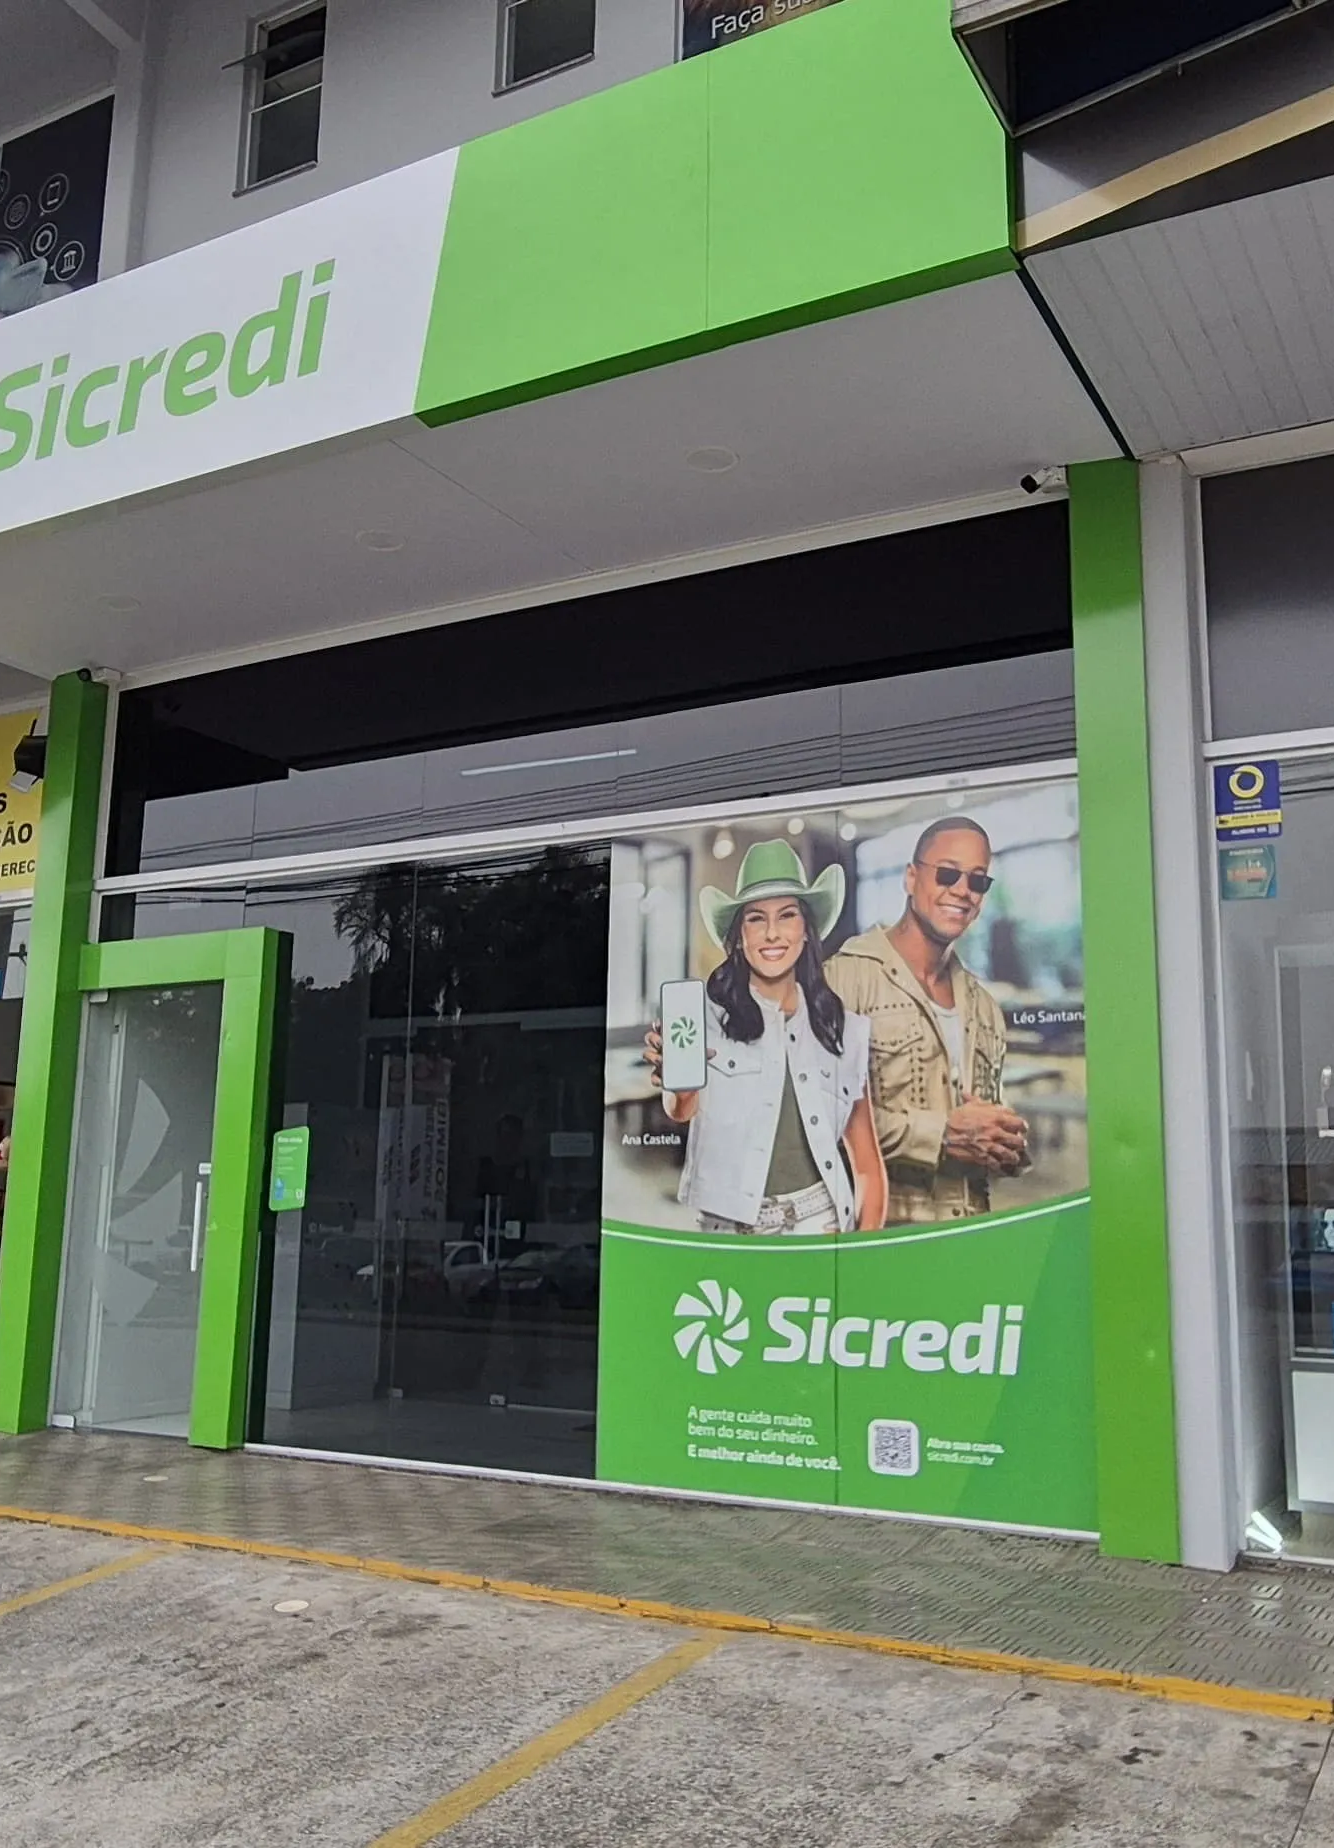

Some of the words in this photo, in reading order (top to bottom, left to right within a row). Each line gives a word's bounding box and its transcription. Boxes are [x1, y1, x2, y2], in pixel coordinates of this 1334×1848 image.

[711, 4, 764, 39] Faça
[1013, 1011, 1036, 1025] Léo
[621, 1133, 641, 1146] Ana
[642, 1132, 681, 1146] Castela
[762, 1296, 1024, 1376] Sicredi
[687, 1405, 698, 1419] A
[699, 1409, 735, 1423] gente
[736, 1410, 772, 1425] cuida
[773, 1414, 813, 1428] muito
[687, 1422, 715, 1436] bem
[717, 1425, 734, 1438] do
[735, 1428, 759, 1441] seu
[761, 1428, 819, 1446] dinheiro.
[698, 1447, 745, 1462] melhor
[746, 1450, 784, 1465] ainda
[785, 1453, 803, 1467] de
[805, 1456, 842, 1471] você.
